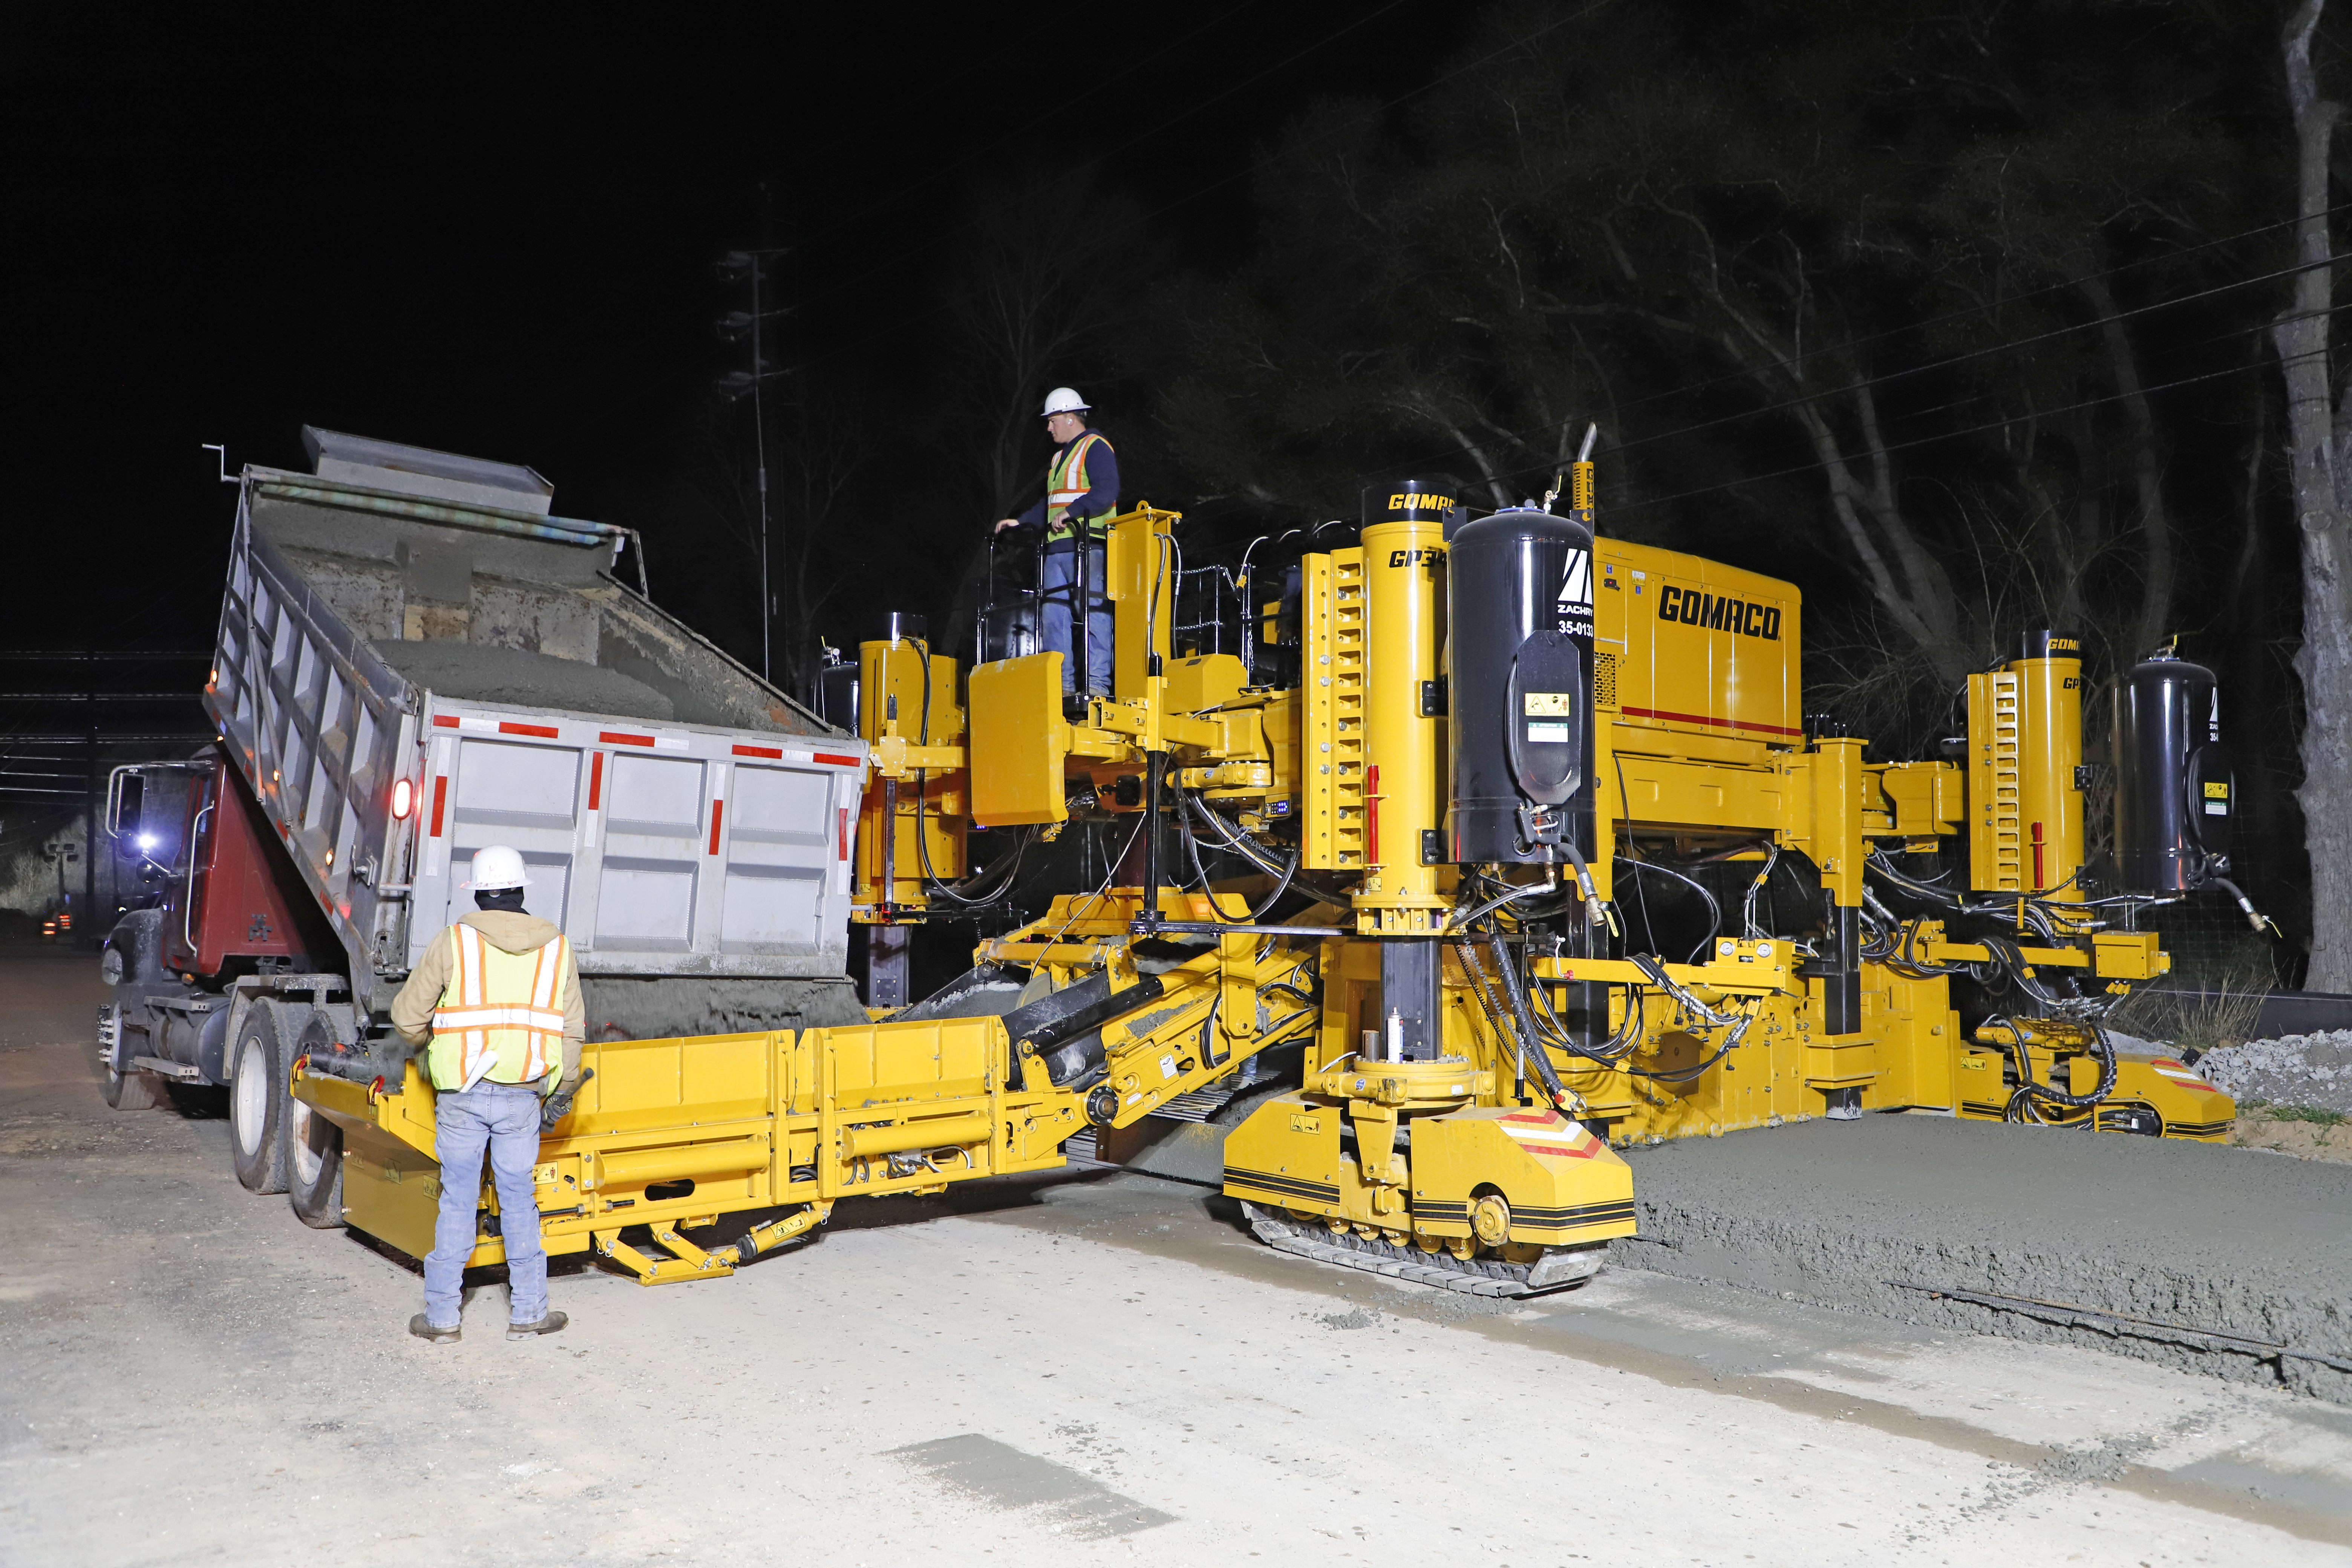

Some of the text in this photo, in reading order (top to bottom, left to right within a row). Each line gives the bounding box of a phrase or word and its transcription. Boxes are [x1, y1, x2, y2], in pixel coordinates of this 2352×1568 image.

[1557, 604, 1593, 617] ZACHRY
[1658, 585, 1781, 641] GOMACO
[1558, 620, 1593, 638] 35-0133
